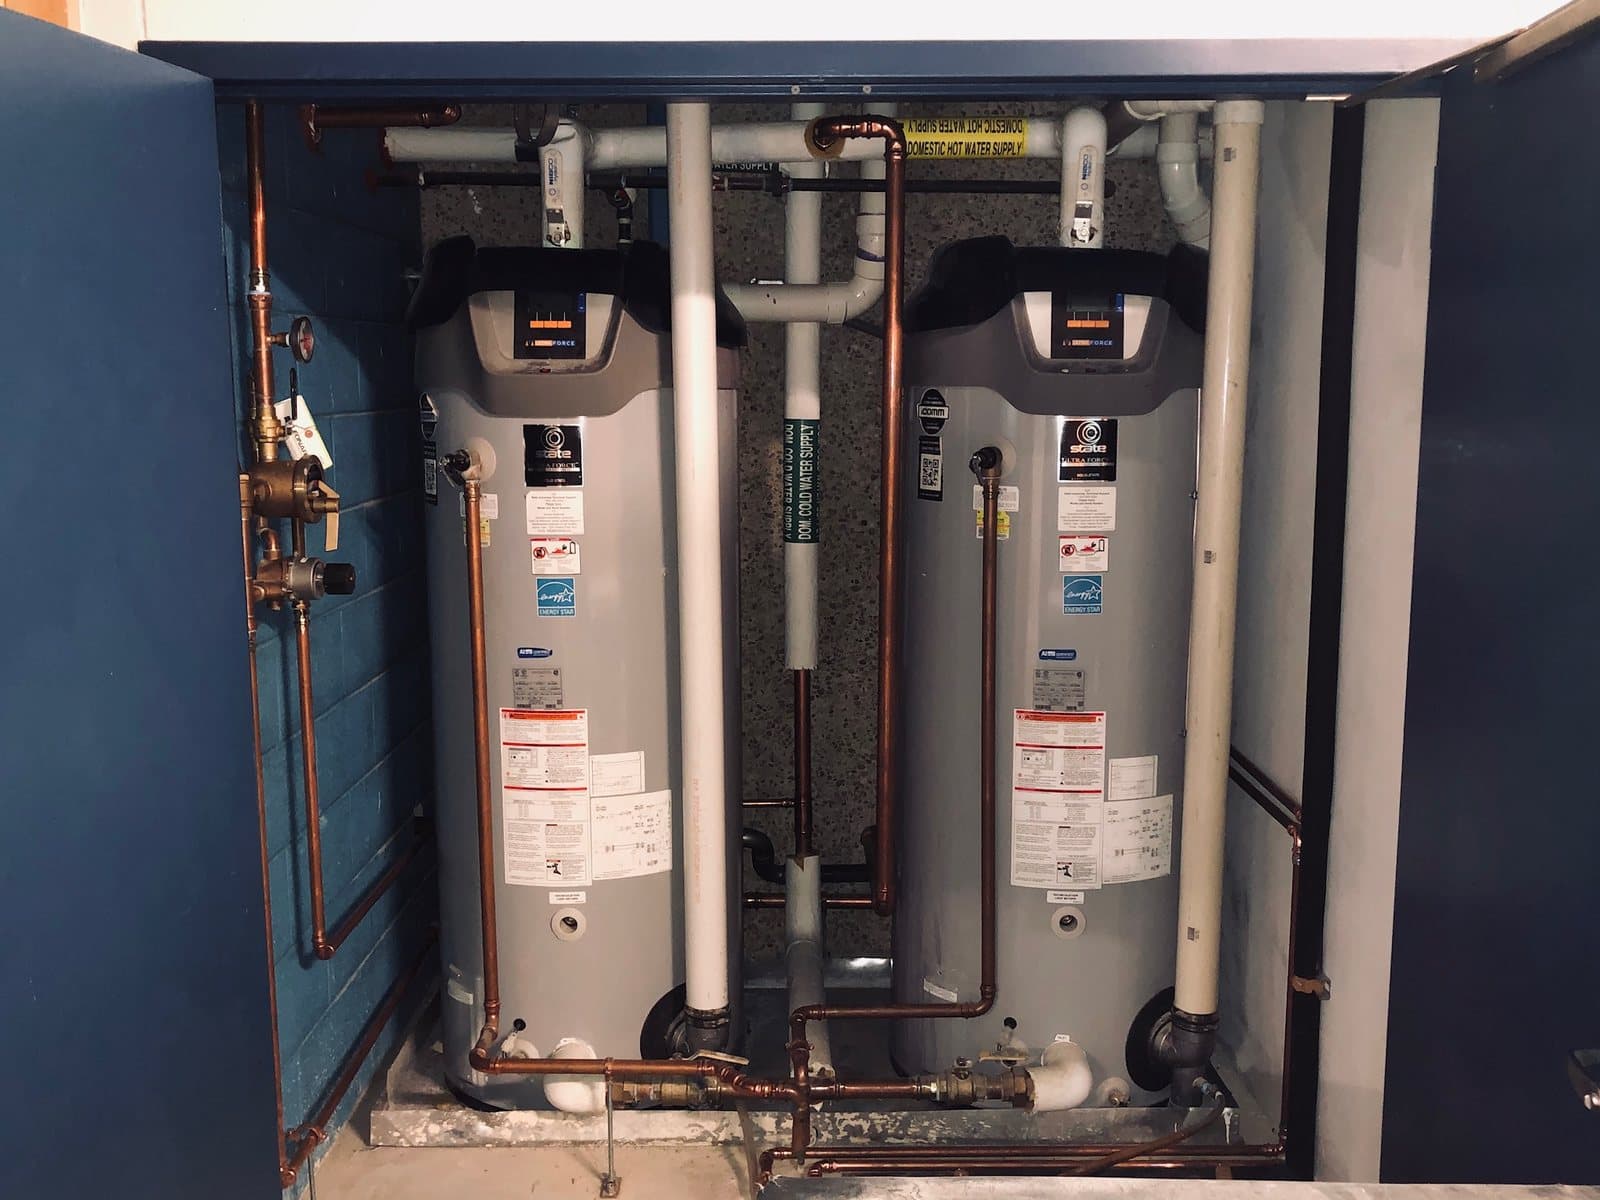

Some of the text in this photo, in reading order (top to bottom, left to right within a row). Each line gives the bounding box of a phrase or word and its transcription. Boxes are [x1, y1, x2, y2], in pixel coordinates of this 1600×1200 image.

[908, 119, 1022, 133] DOMESTIC HOT WATER SUPPLY
[907, 141, 1021, 156] DOMESTIC HOT WATER SUPPLY
[712, 162, 738, 170] ATER
[1070, 444, 1107, 454] state
[798, 424, 814, 540] DOM. COLD WATER SUPPLY
